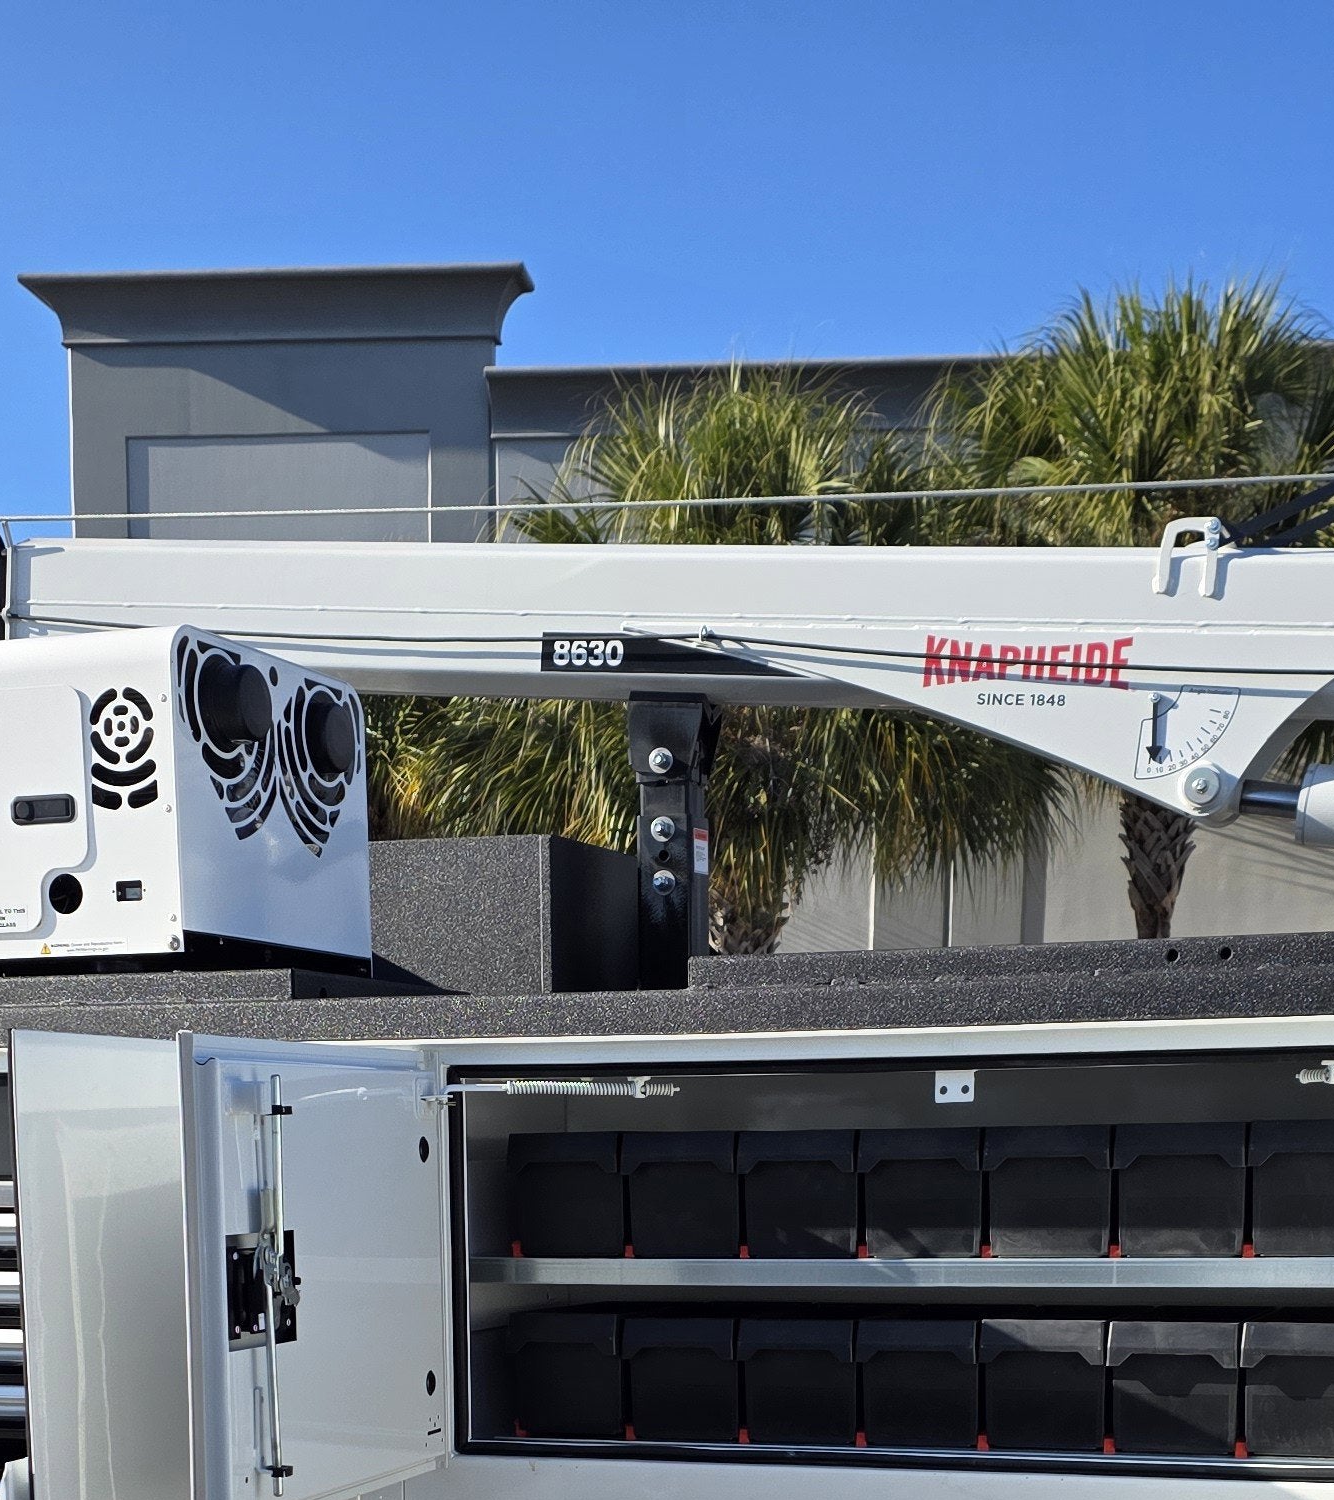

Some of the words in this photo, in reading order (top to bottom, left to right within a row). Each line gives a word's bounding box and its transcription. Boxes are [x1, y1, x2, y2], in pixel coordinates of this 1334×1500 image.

[552, 640, 624, 667] 8630
[923, 634, 1134, 690] KNAPHEIDE
[976, 692, 1026, 707] SINCE
[1029, 693, 1067, 707] 1848
[1146, 766, 1152, 774] 0
[1155, 765, 1164, 774] 10
[1168, 763, 1177, 772] 20
